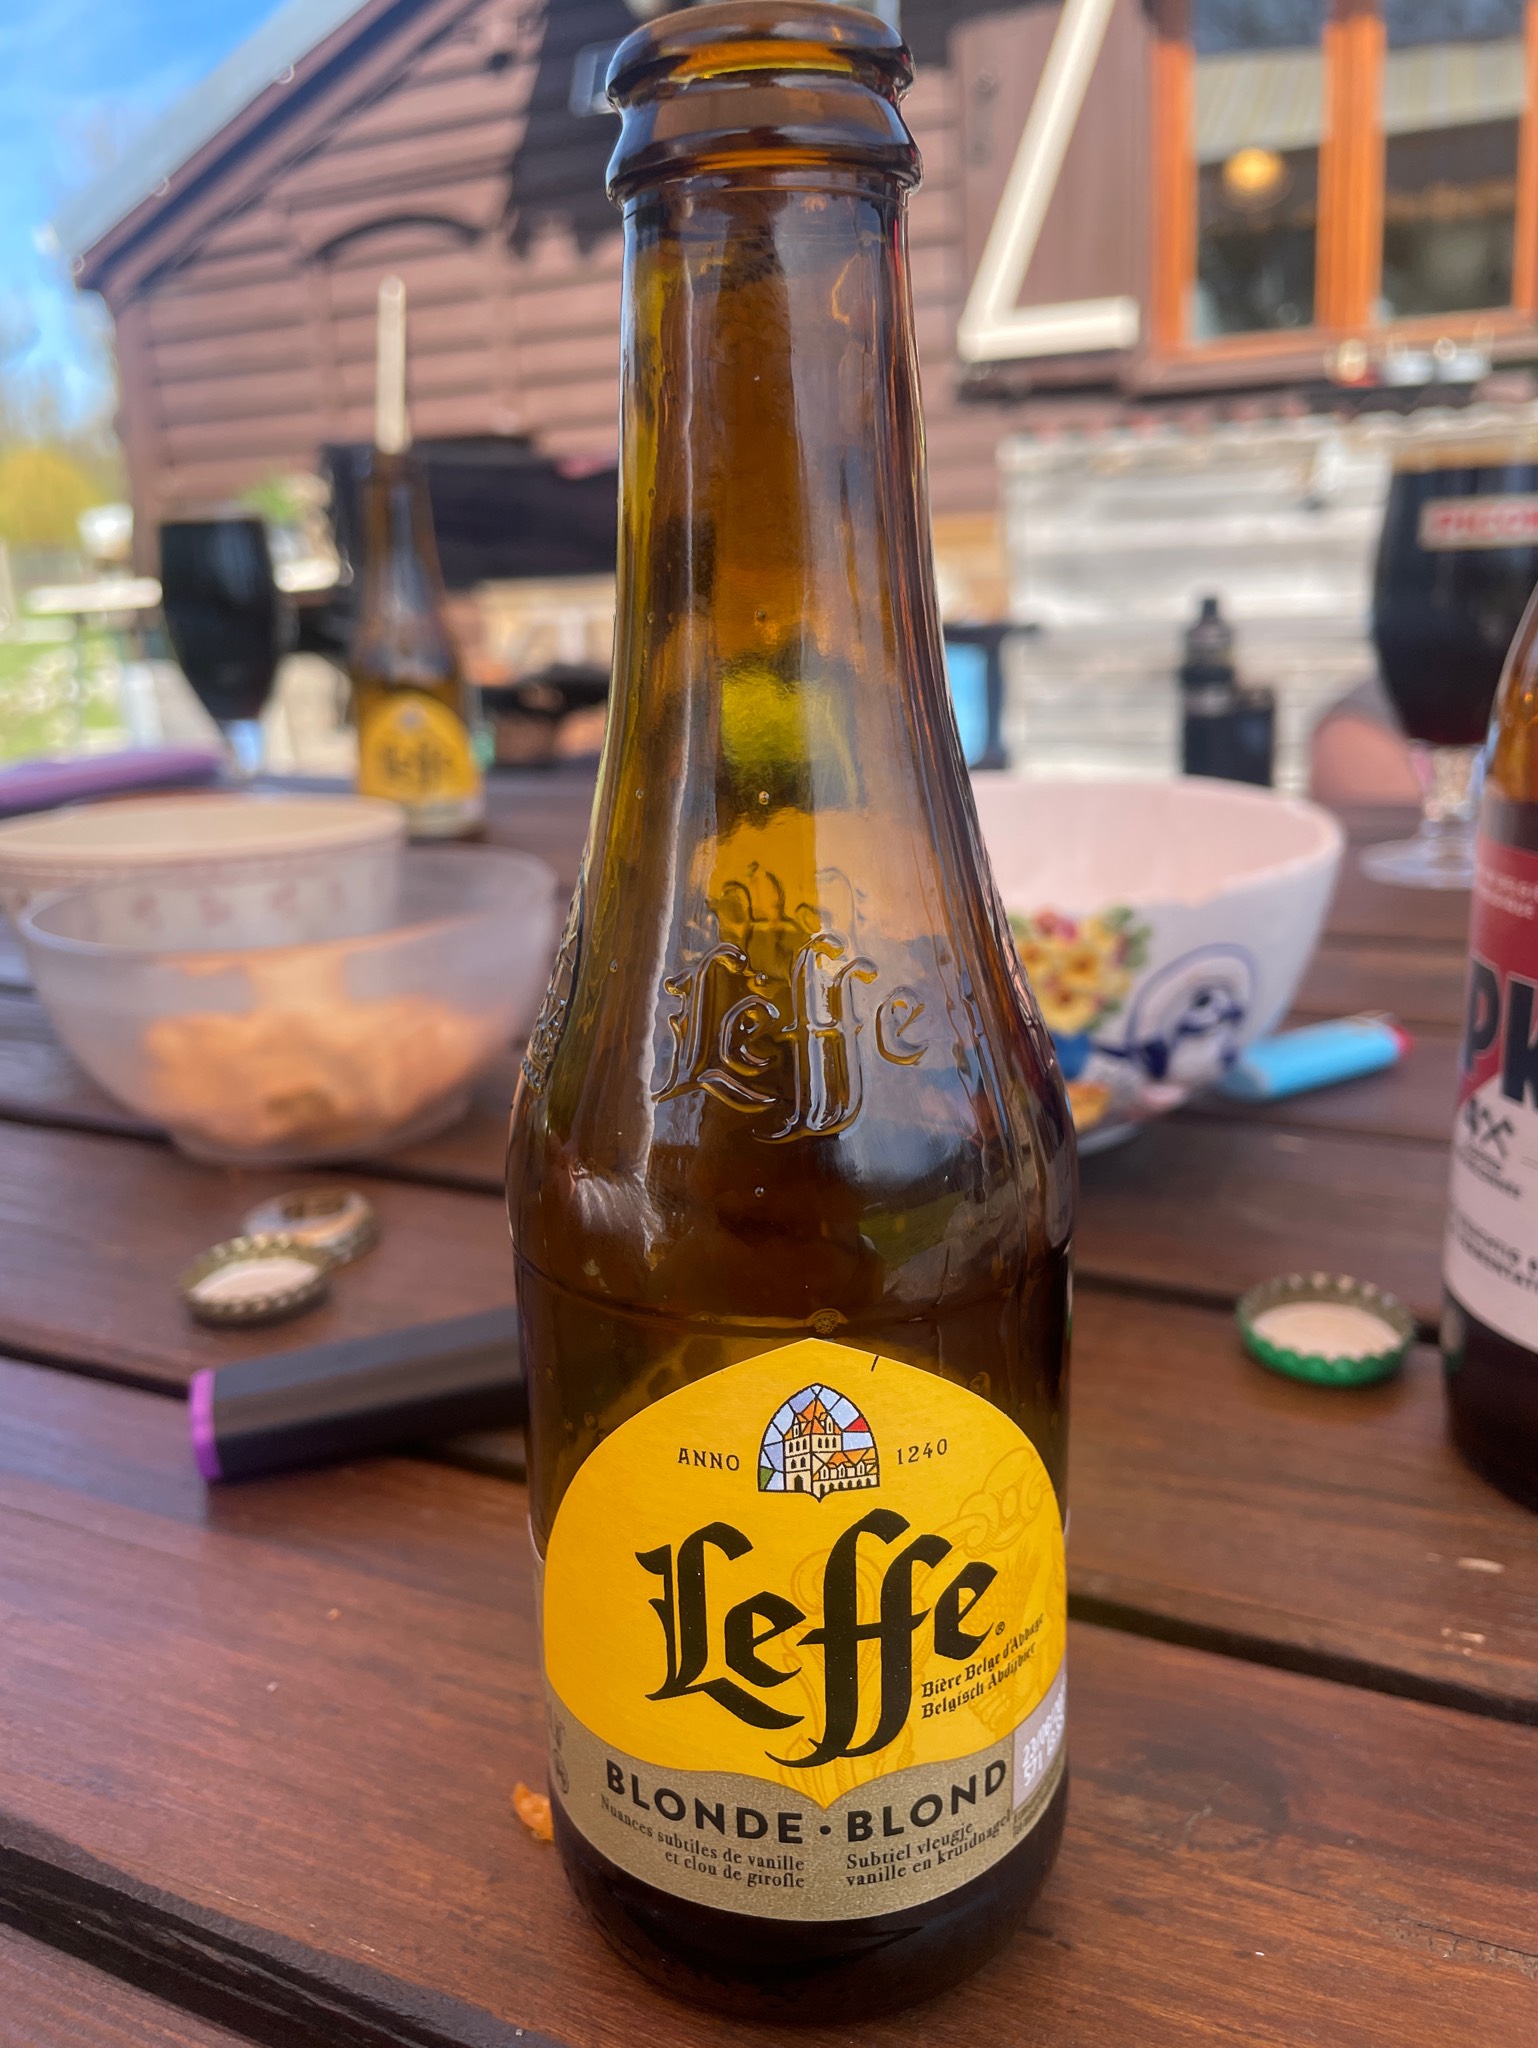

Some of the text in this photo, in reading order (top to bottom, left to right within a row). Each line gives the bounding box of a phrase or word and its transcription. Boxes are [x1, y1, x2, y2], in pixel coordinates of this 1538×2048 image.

[651, 932, 929, 1144] Leffe
[677, 1438, 948, 1471] ANNO 1240
[635, 1507, 998, 1769] Leffe
[921, 1674, 962, 1698] Bière
[965, 1652, 1000, 1682] Belge
[921, 1682, 984, 1719] Belgisch
[606, 1758, 1006, 1844] BLONDE BLOND
[601, 1794, 805, 1871] Nuances subtiles de vanille
[846, 1864, 907, 1886] vanille
[912, 1859, 932, 1873] en
[937, 1808, 1011, 1866] kruidnagel
[847, 1821, 973, 1869] Subtiel vleugje
[665, 1850, 805, 1888] et clou de girofle
